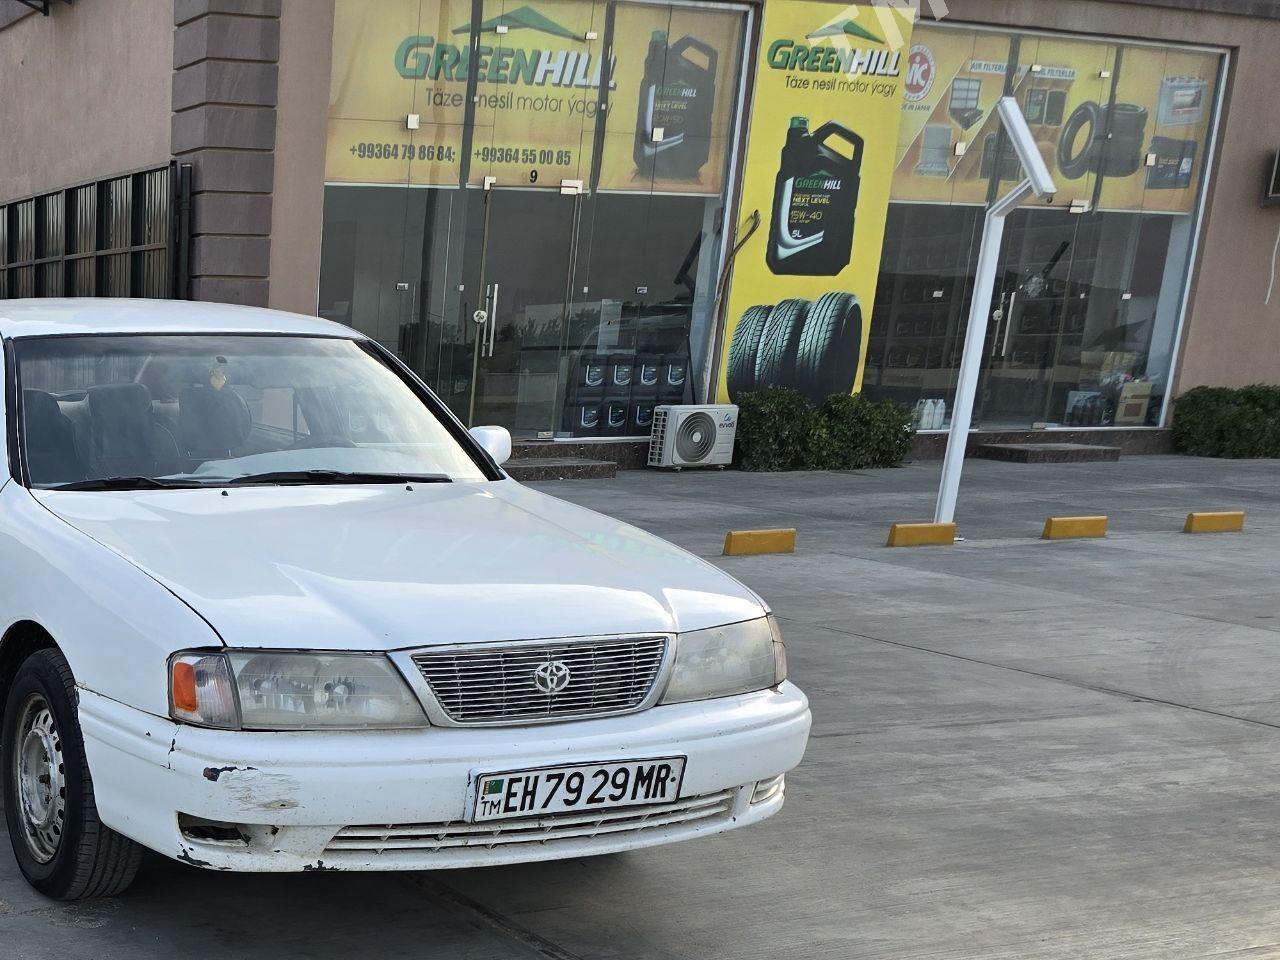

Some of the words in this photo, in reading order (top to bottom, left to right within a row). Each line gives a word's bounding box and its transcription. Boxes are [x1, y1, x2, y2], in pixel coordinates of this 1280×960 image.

[395, 35, 617, 91] GREENHILL
[767, 39, 900, 77] GREENHILL
[785, 75, 809, 89] Täze
[812, 78, 836, 91] nesil
[838, 79, 868, 93] motor
[426, 87, 463, 108] Täze
[478, 91, 513, 109] nesil
[517, 93, 562, 112] motor
[350, 143, 399, 160] +99364
[402, 144, 415, 160] 79
[418, 145, 435, 161] 86
[474, 146, 519, 163] +99364
[522, 149, 537, 164] 55
[539, 150, 553, 165] 00
[556, 150, 571, 166] 85
[530, 169, 538, 183] 9
[795, 177, 841, 190] GREENHILL
[792, 229, 802, 238] 5L
